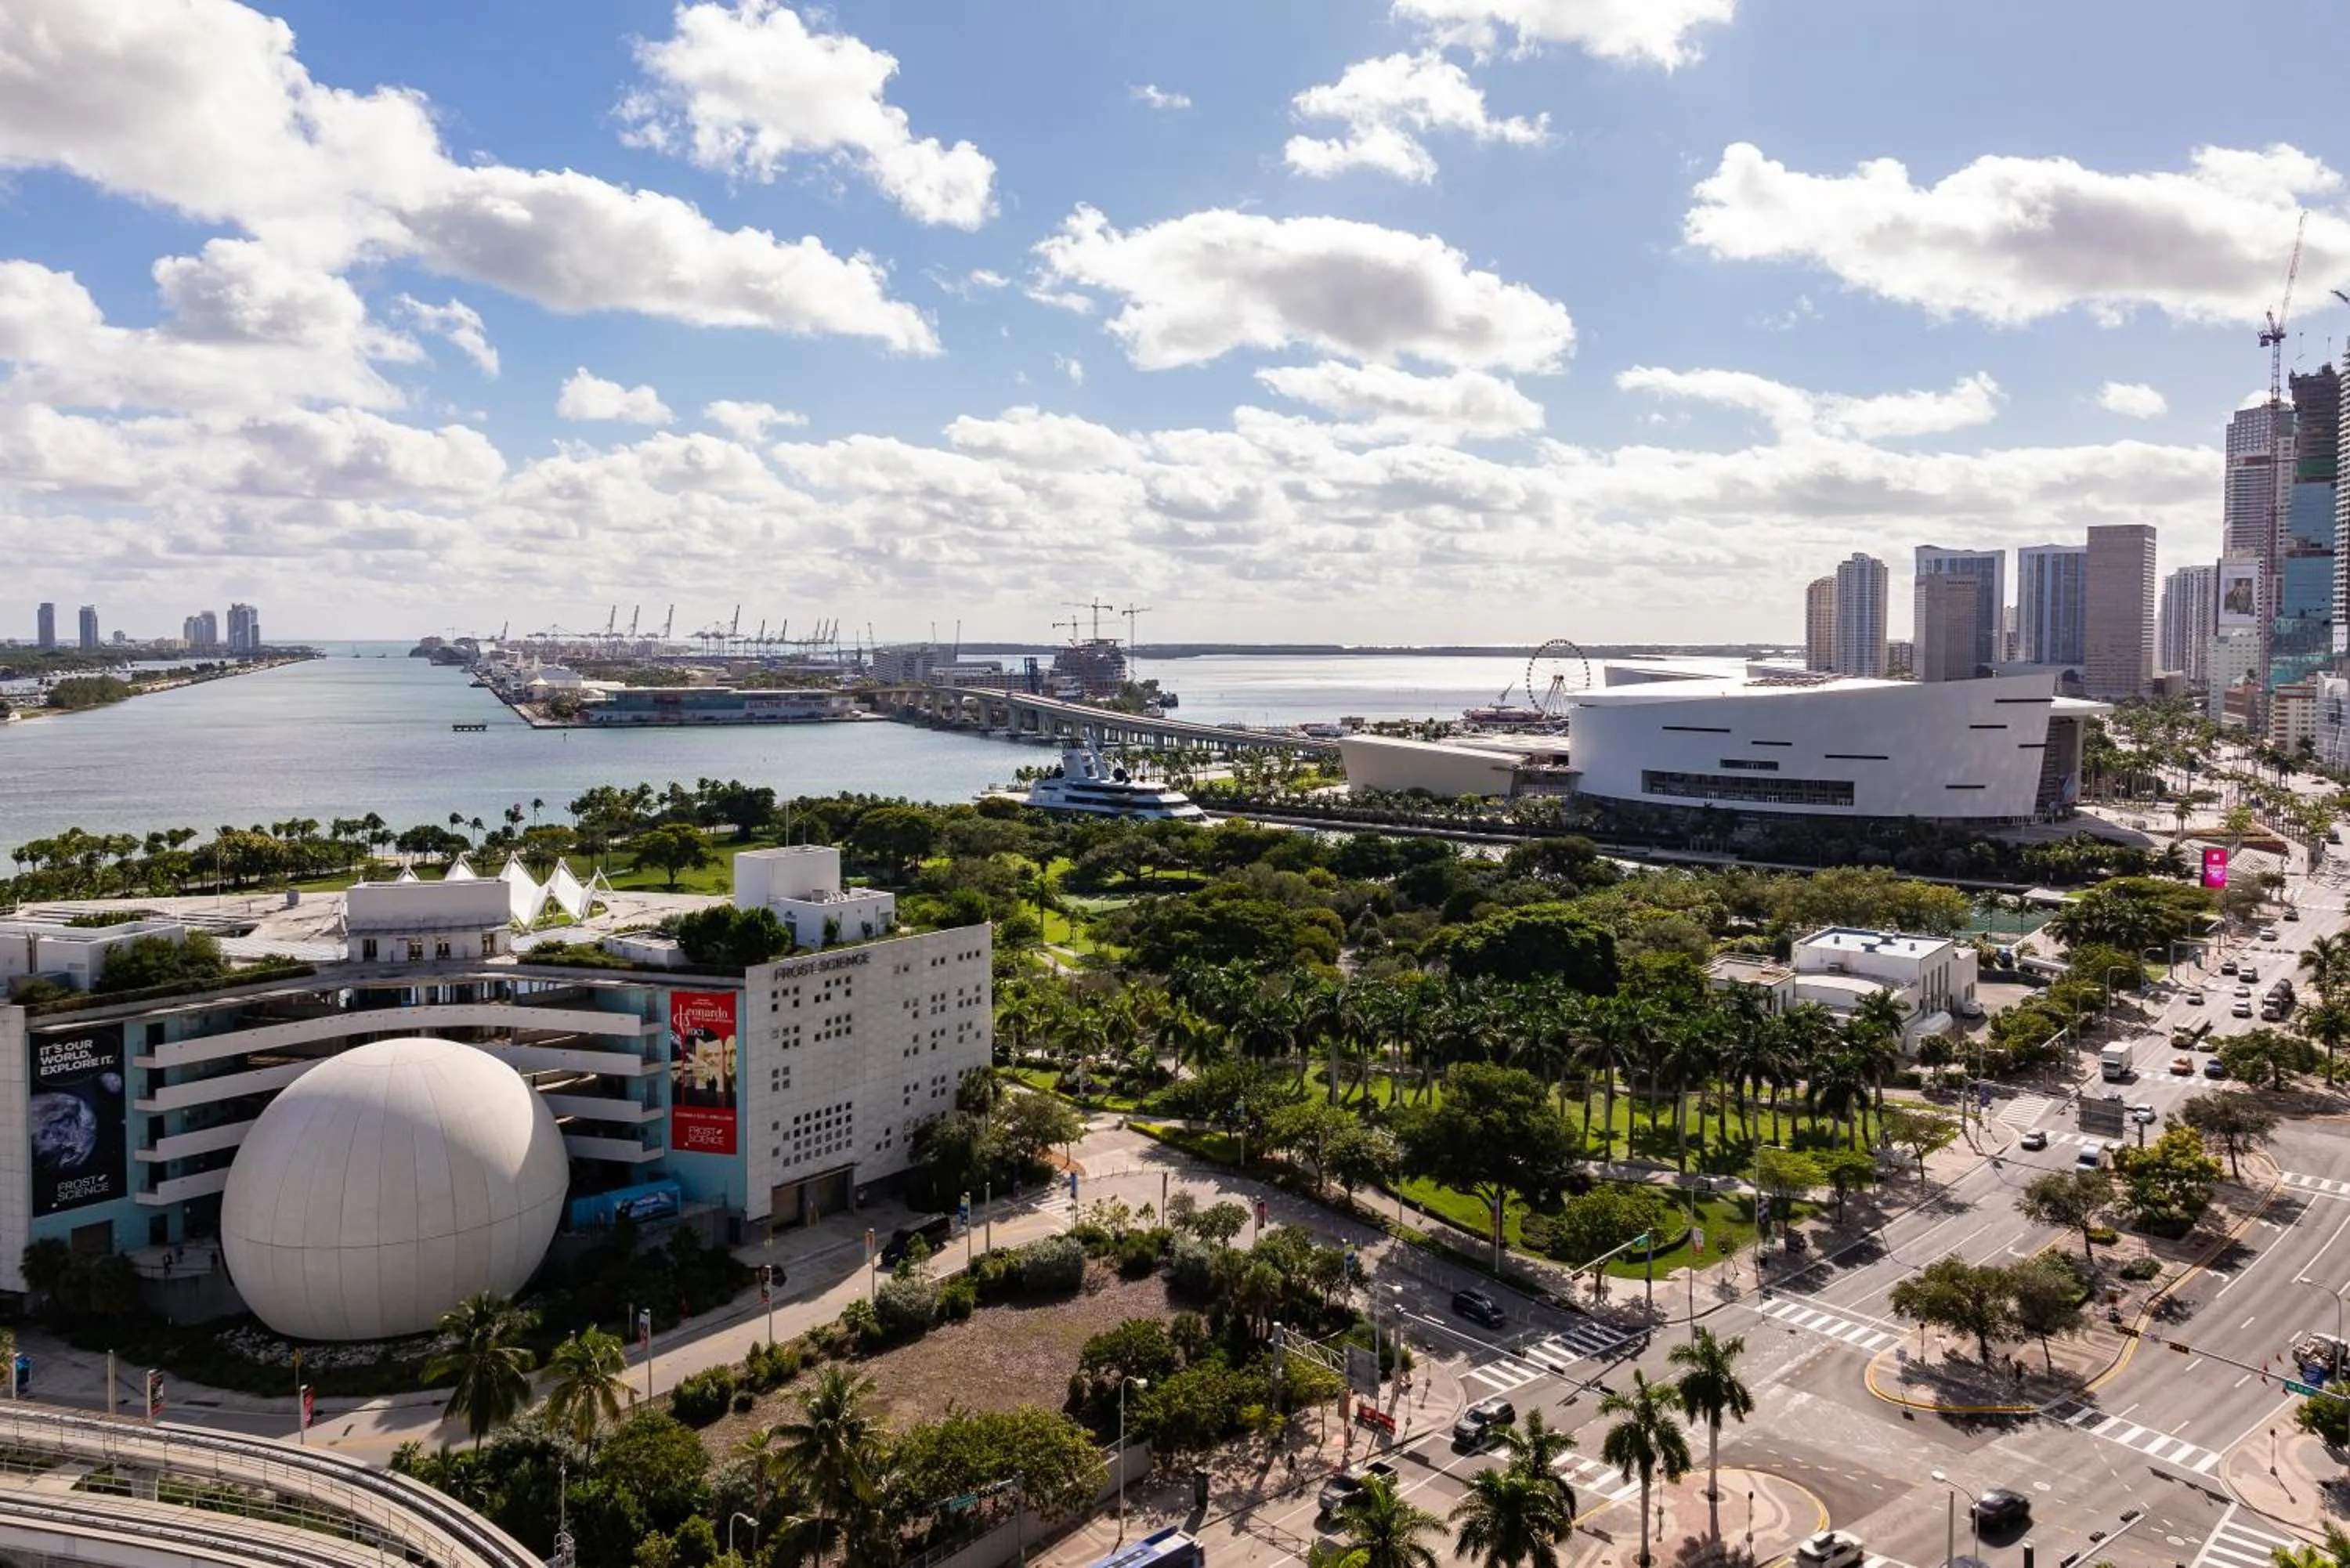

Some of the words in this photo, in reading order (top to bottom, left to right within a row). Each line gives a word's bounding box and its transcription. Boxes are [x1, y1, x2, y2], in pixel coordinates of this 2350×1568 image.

[774, 961, 815, 981] FROST
[819, 952, 871, 973] SCIENCE
[39, 1043, 63, 1057] IT'S
[64, 1039, 93, 1052] OUR
[40, 1050, 92, 1066] WORLD,
[40, 1057, 99, 1076] EXPLORE
[100, 1055, 114, 1065] IT.
[689, 1125, 716, 1135] FROST
[689, 1134, 725, 1147] SCIENCE
[56, 1182, 110, 1202] SCIENCE
[57, 1176, 96, 1191] FROST
